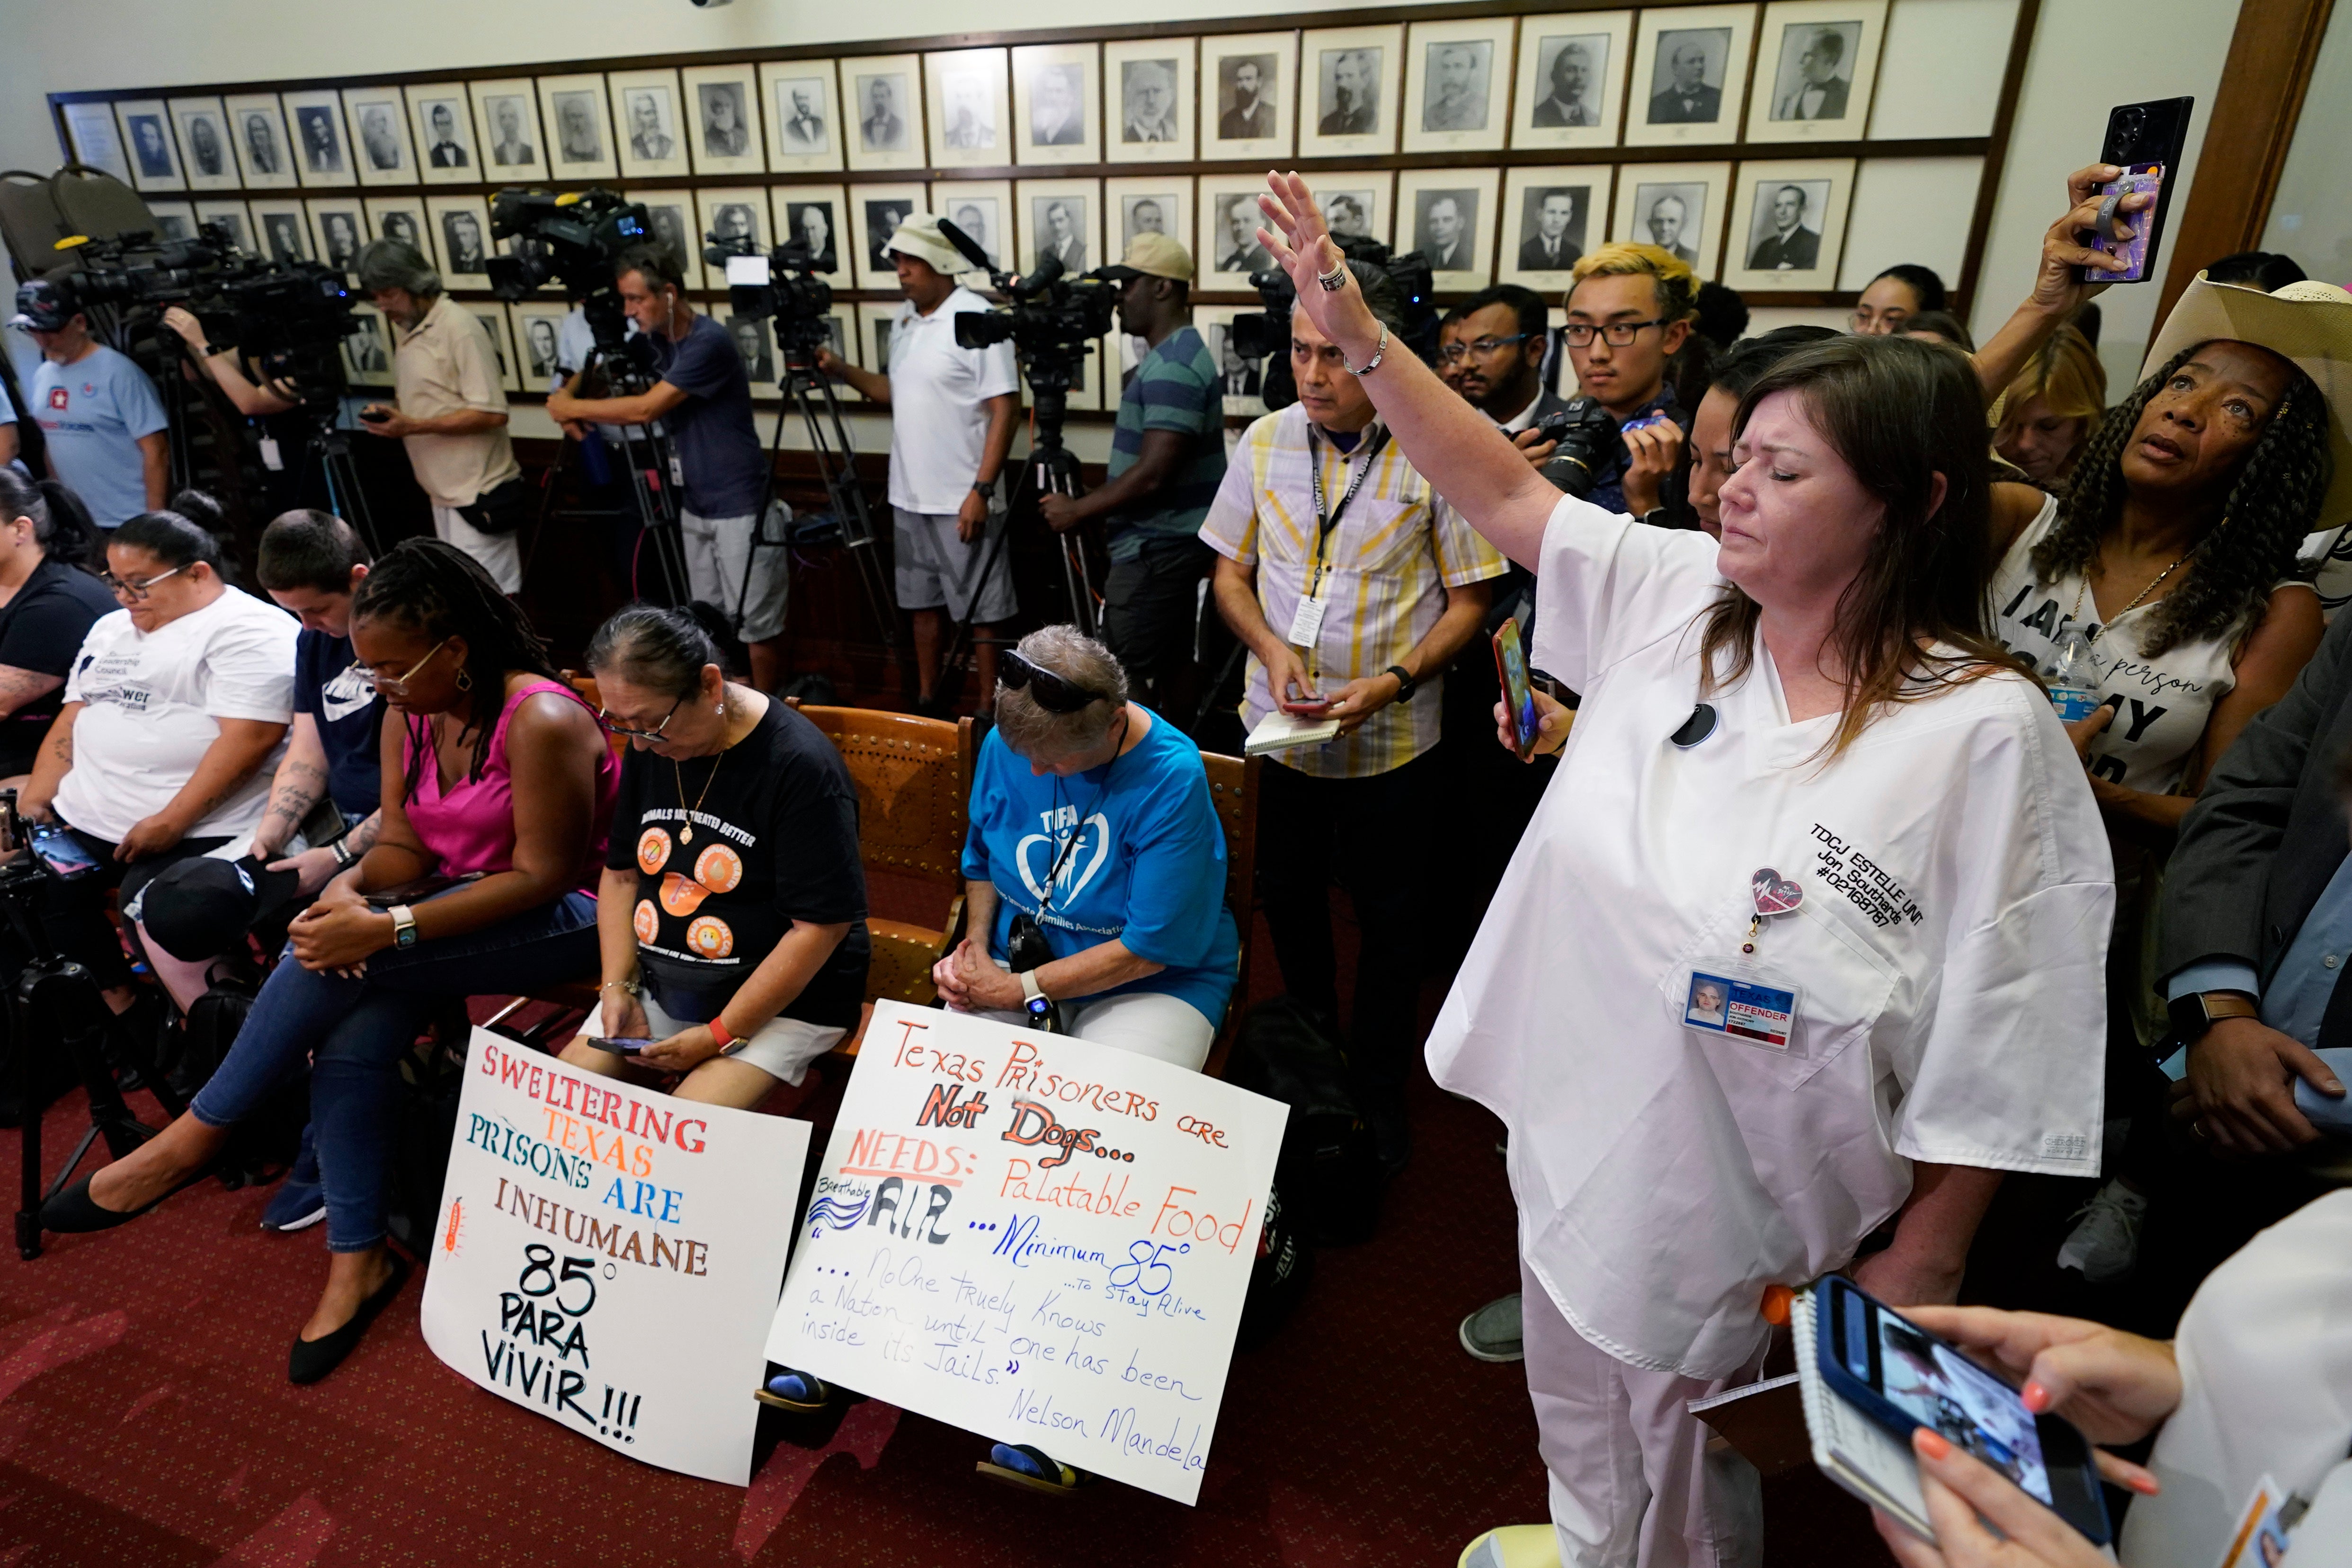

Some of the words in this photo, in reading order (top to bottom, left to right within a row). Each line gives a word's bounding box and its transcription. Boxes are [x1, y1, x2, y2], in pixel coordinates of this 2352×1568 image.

[2104, 658, 2202, 695] person
[719, 822, 757, 847] BETTER
[1040, 804, 1078, 833] TIFA
[1811, 823, 1850, 855] TDCJ
[1850, 852, 1906, 903] ESTELLE
[1817, 851, 1843, 872] Jon
[1847, 870, 1902, 925] Southards
[1042, 913, 1074, 929] amilies
[1817, 866, 1889, 928] #02168787
[1729, 1002, 1787, 1022] OFFENDER
[1734, 989, 1771, 1002] TEXAS
[893, 1020, 983, 1084] Texas
[481, 1044, 707, 1154] SWELTERING
[916, 1083, 989, 1130] Not
[466, 1113, 592, 1189] PRISONS
[602, 1177, 683, 1225] ARE
[543, 1108, 653, 1177] TEXAS
[846, 1129, 977, 1176] NEEDS:
[1149, 1185, 1252, 1255] Food
[494, 1177, 708, 1276] INHUMANE
[499, 1292, 589, 1369] PARA
[802, 1312, 865, 1345] inside
[884, 1330, 914, 1362] its
[810, 1289, 824, 1303] a
[835, 1279, 914, 1325] Nation
[1066, 1336, 1108, 1375] has
[1122, 1348, 1203, 1400] been
[1100, 1408, 1206, 1470] Mandela
